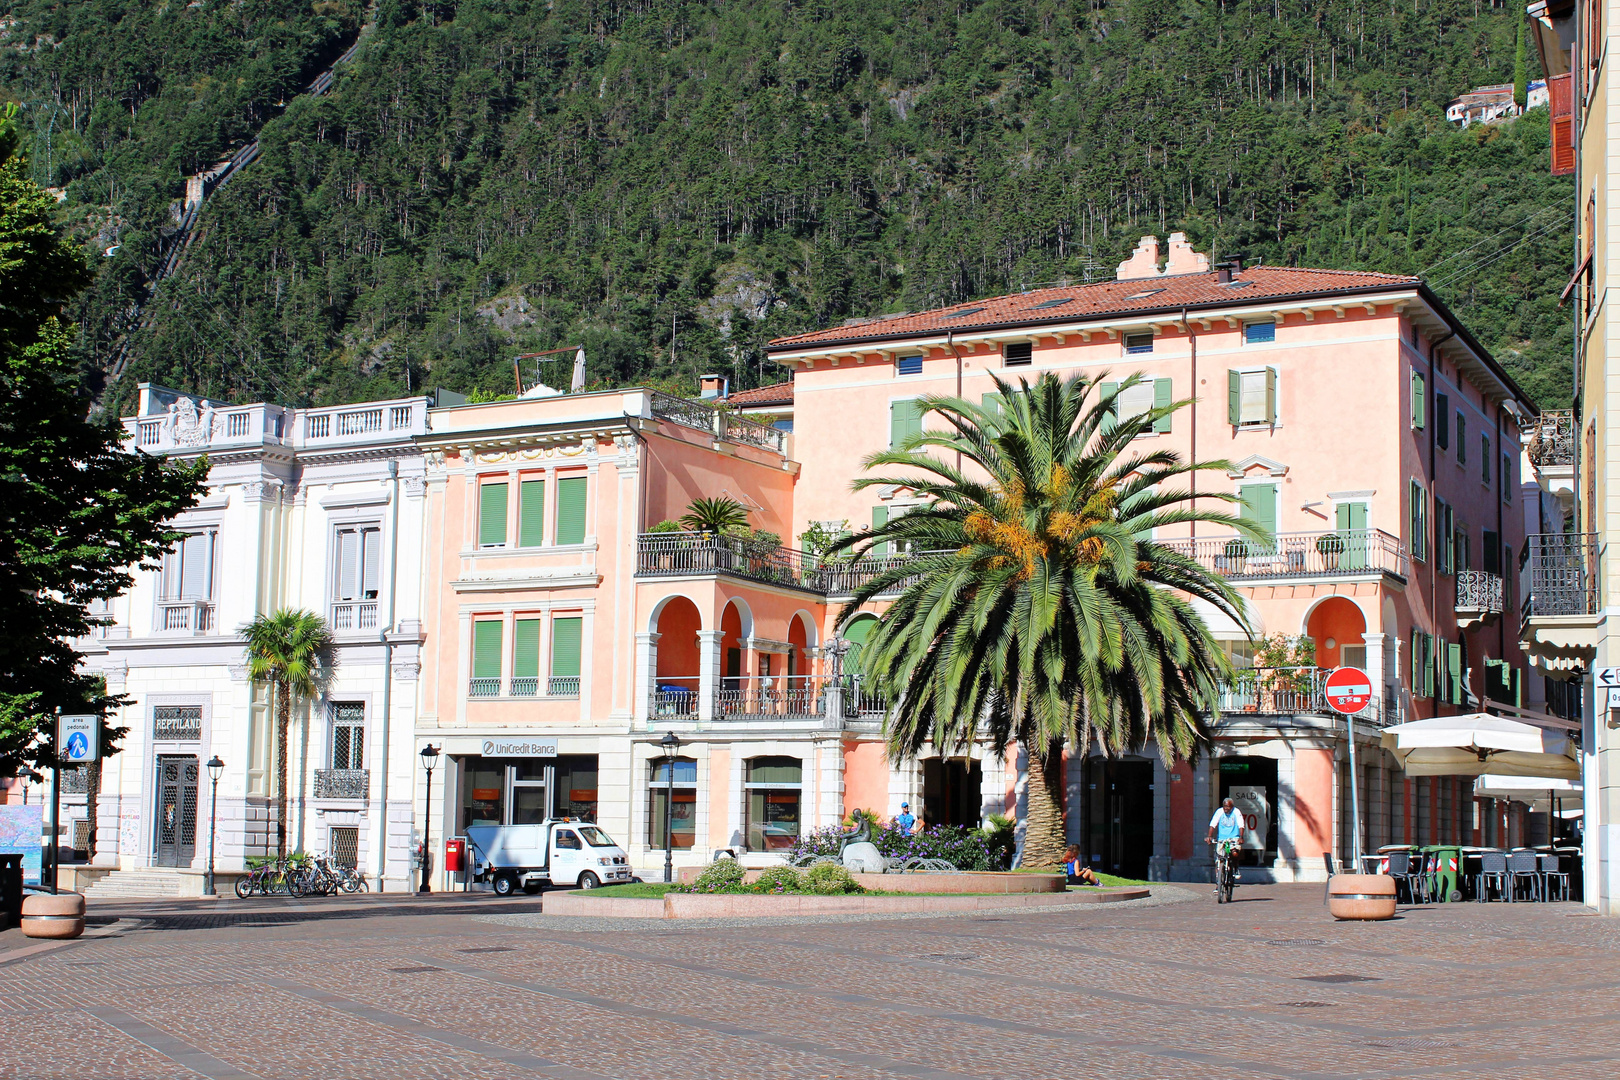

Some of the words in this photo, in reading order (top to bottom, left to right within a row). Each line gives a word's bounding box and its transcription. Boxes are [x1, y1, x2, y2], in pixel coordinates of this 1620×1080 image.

[156, 718, 202, 730] REPTILAND
[496, 742, 530, 754] UniCredit
[531, 743, 555, 754] Banca
